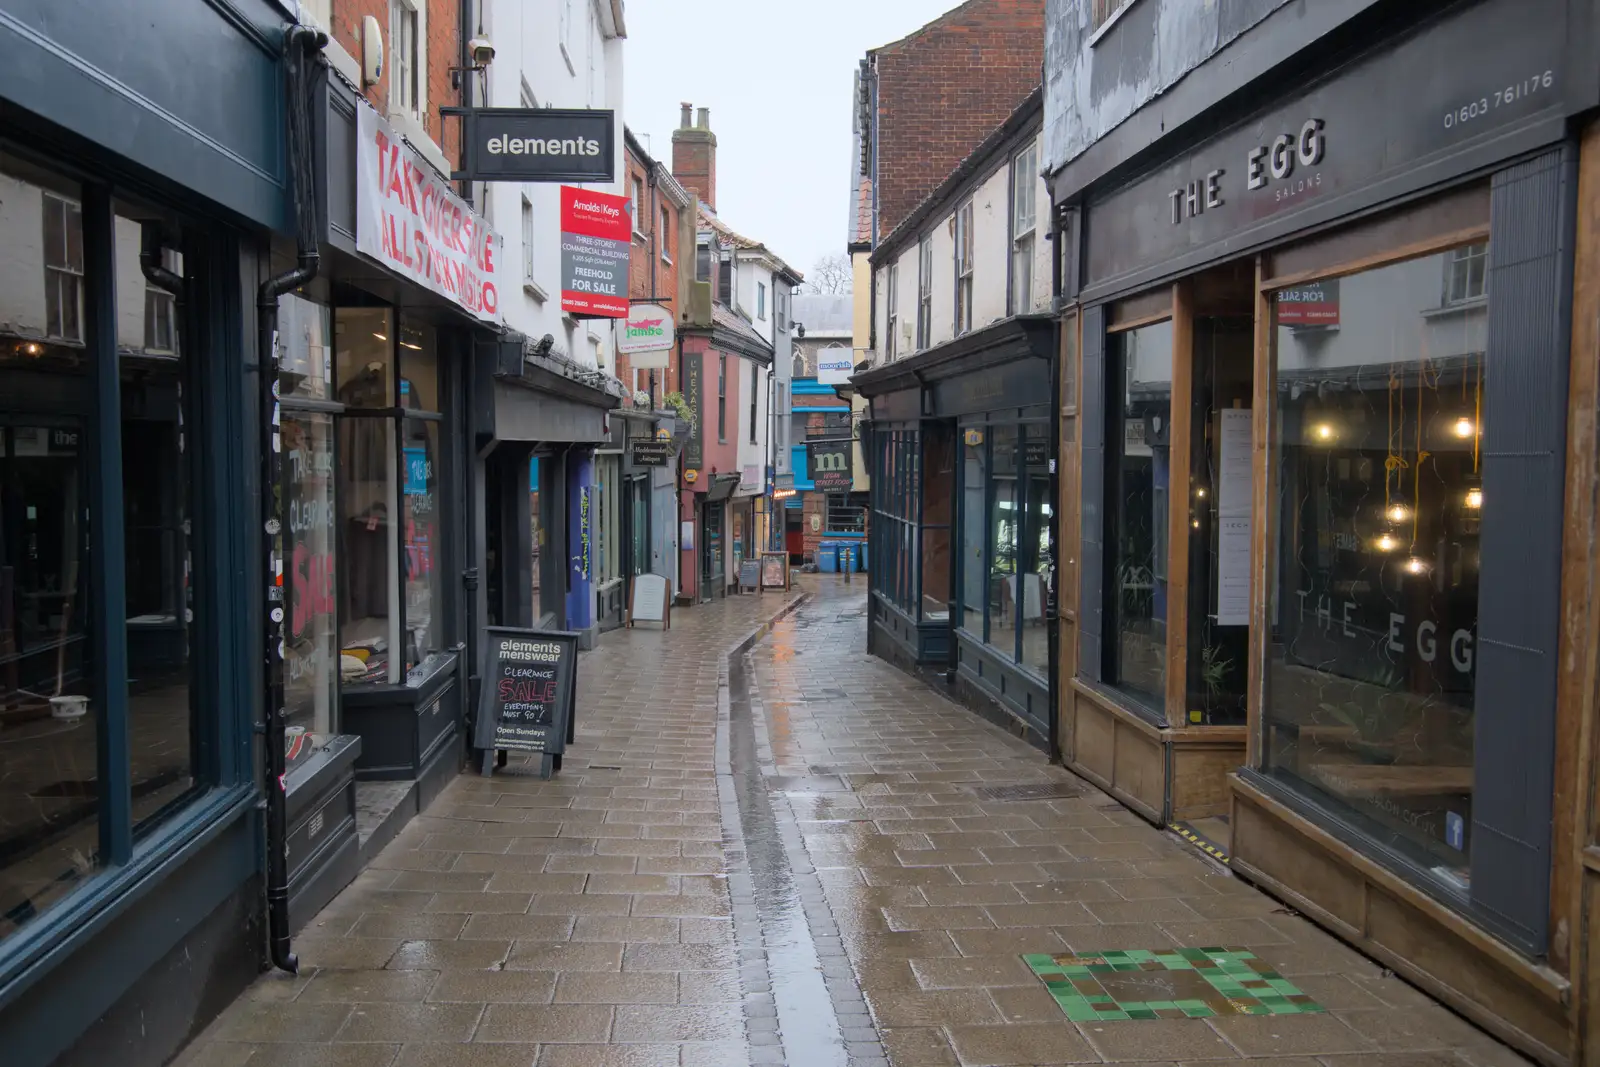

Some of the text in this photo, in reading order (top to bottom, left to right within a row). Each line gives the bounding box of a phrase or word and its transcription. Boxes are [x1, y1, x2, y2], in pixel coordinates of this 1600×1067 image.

[1443, 69, 1554, 129] 01603 761176
[487, 133, 600, 156] elements
[1168, 117, 1327, 225] THE EGG
[1275, 172, 1322, 202] SALONS
[381, 205, 413, 268] ALL
[575, 235, 617, 249] THREE-STOREY
[562, 243, 629, 260] COMMERCIAL BUILDING
[575, 266, 613, 280] FREEHOLD
[572, 279, 616, 294] FOR SALE
[626, 326, 664, 339] jambo
[819, 360, 852, 369] moorish
[1297, 589, 1473, 673] THE EGG
[500, 639, 561, 653] elements
[499, 650, 561, 662] menswear
[504, 666, 554, 679] CLEARANCE
[498, 677, 558, 703] SALE
[502, 710, 521, 718] MUST
[496, 726, 546, 738] Open Sundays
